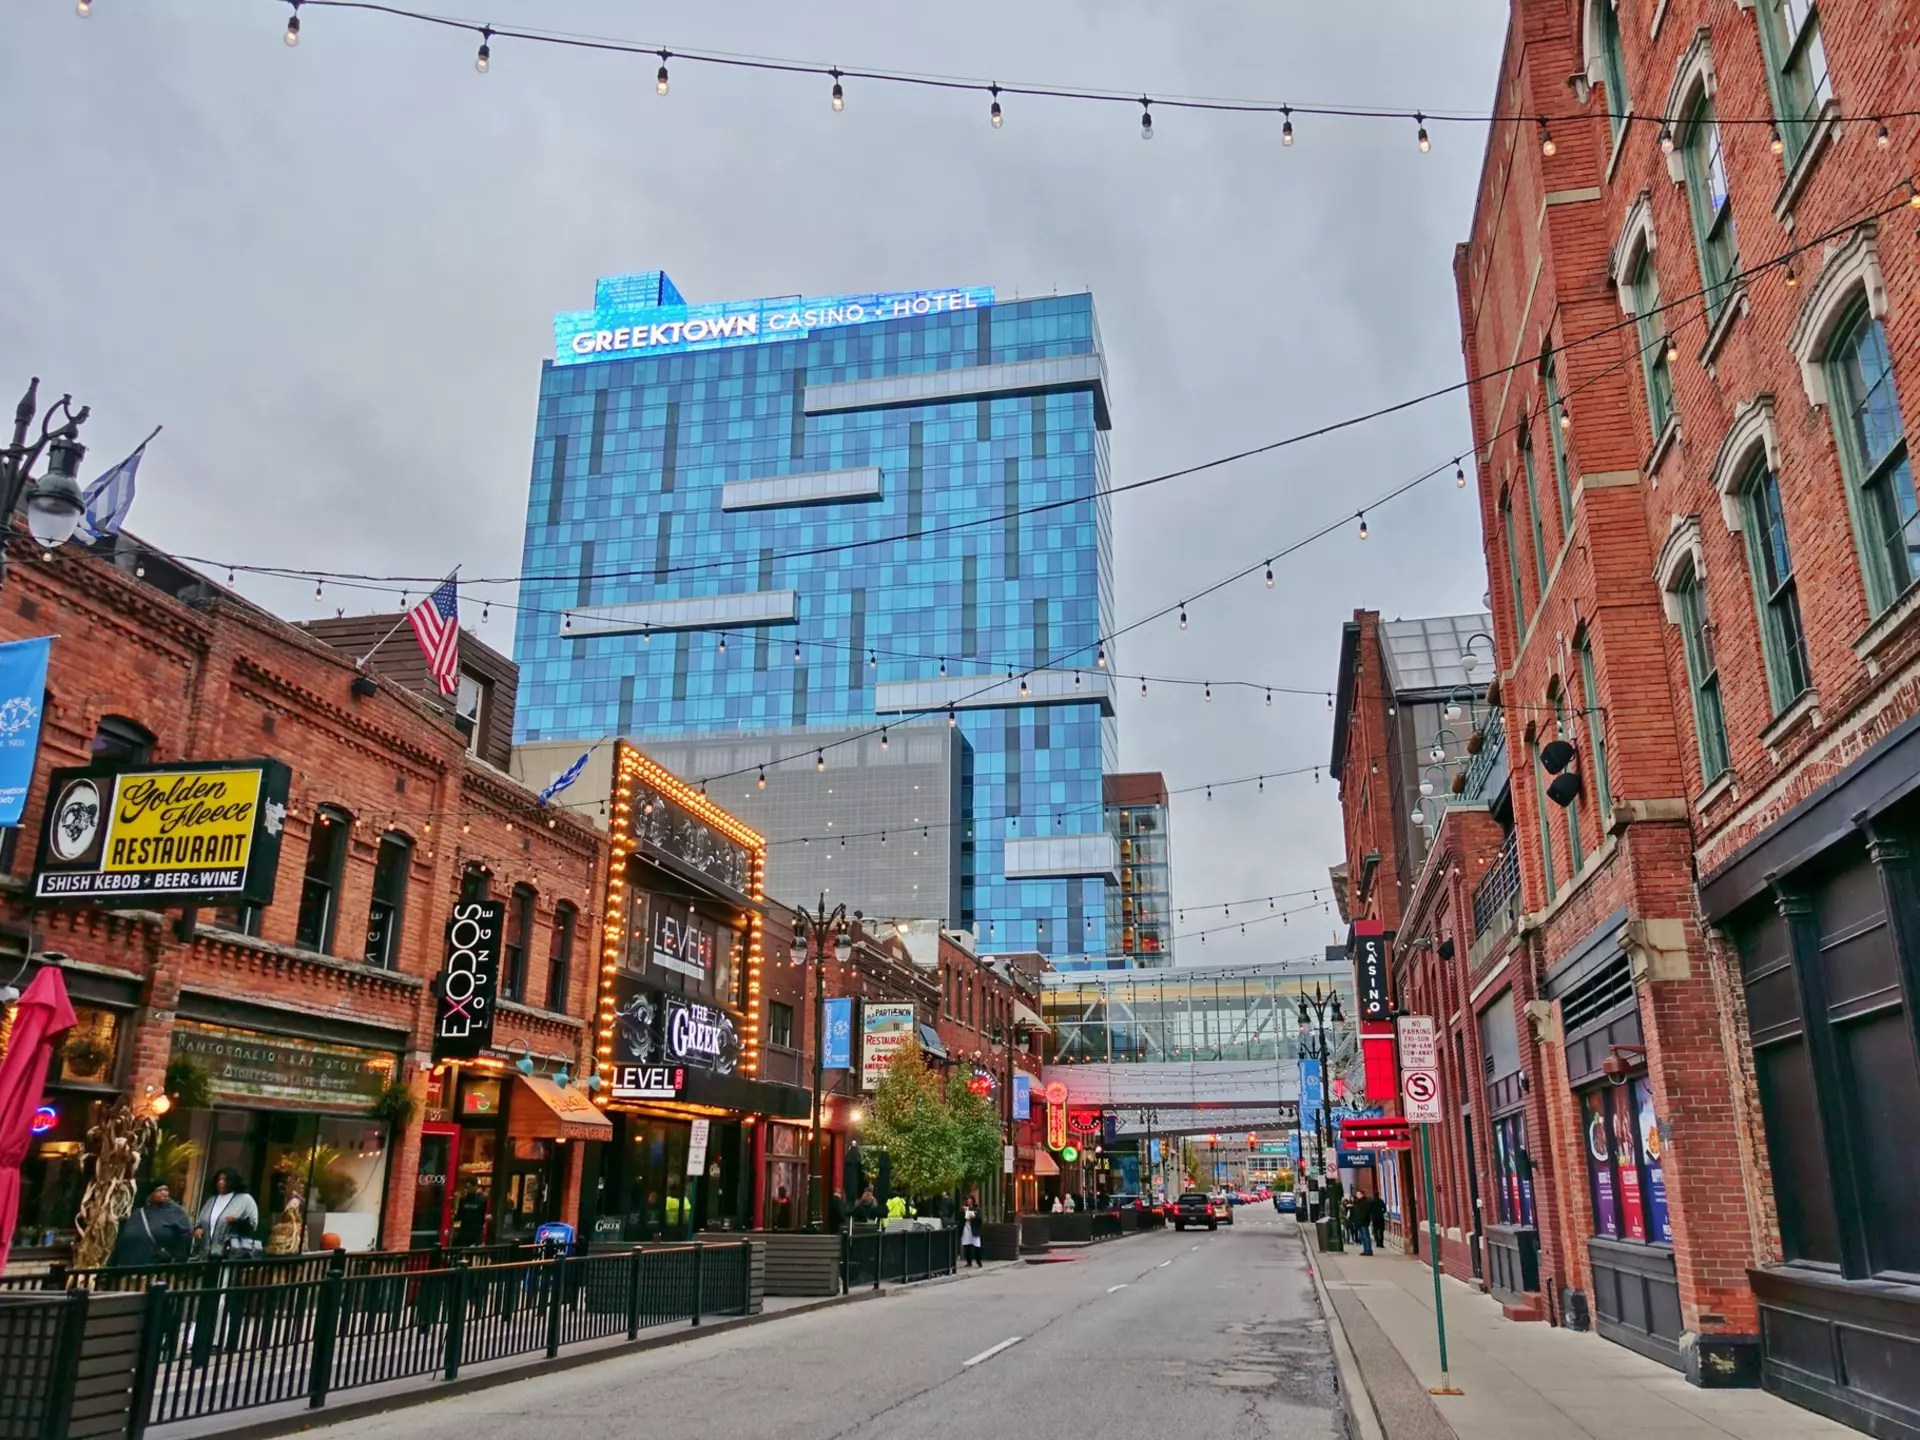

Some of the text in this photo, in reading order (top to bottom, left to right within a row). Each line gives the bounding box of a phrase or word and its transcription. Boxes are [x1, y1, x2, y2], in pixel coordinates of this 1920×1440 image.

[571, 292, 977, 355] GREEKTOWN CASINO HOTEL
[120, 776, 228, 824] Golden
[159, 801, 253, 834] Fleece
[111, 834, 247, 865] RESTAURANT
[46, 874, 91, 891] SHISH
[94, 873, 140, 890] KEBOB
[154, 871, 190, 888] BEER
[200, 871, 239, 887] WINE
[653, 911, 705, 967] LEVEL
[441, 904, 482, 1037] EXODOS
[471, 910, 494, 1028] LOUNGE
[1366, 941, 1380, 1012] CASINO
[672, 1008, 721, 1057] GREEK
[691, 1004, 709, 1022] THE
[875, 1008, 911, 1017] PARTHENON
[612, 1067, 674, 1089] LEVEL
[1408, 1111, 1439, 1119] STANDING
